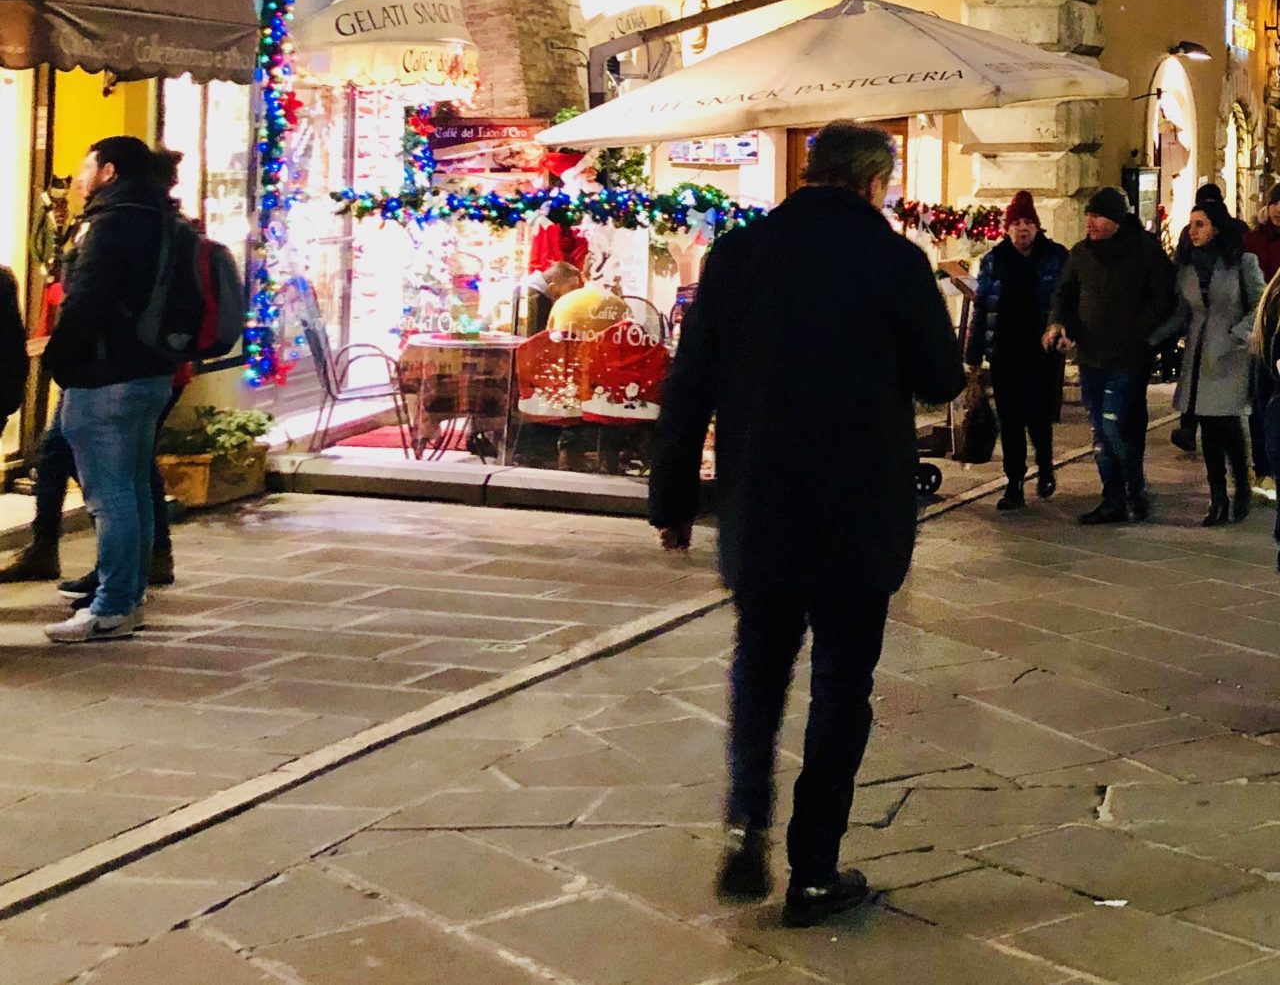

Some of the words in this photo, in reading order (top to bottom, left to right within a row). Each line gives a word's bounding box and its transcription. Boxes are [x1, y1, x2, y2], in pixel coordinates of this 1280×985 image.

[335, 3, 409, 37] GELATI
[696, 88, 787, 106] SNACK
[794, 69, 965, 95] PASTICCERIA
[460, 127, 474, 138] del
[612, 323, 661, 347] d'Oro
